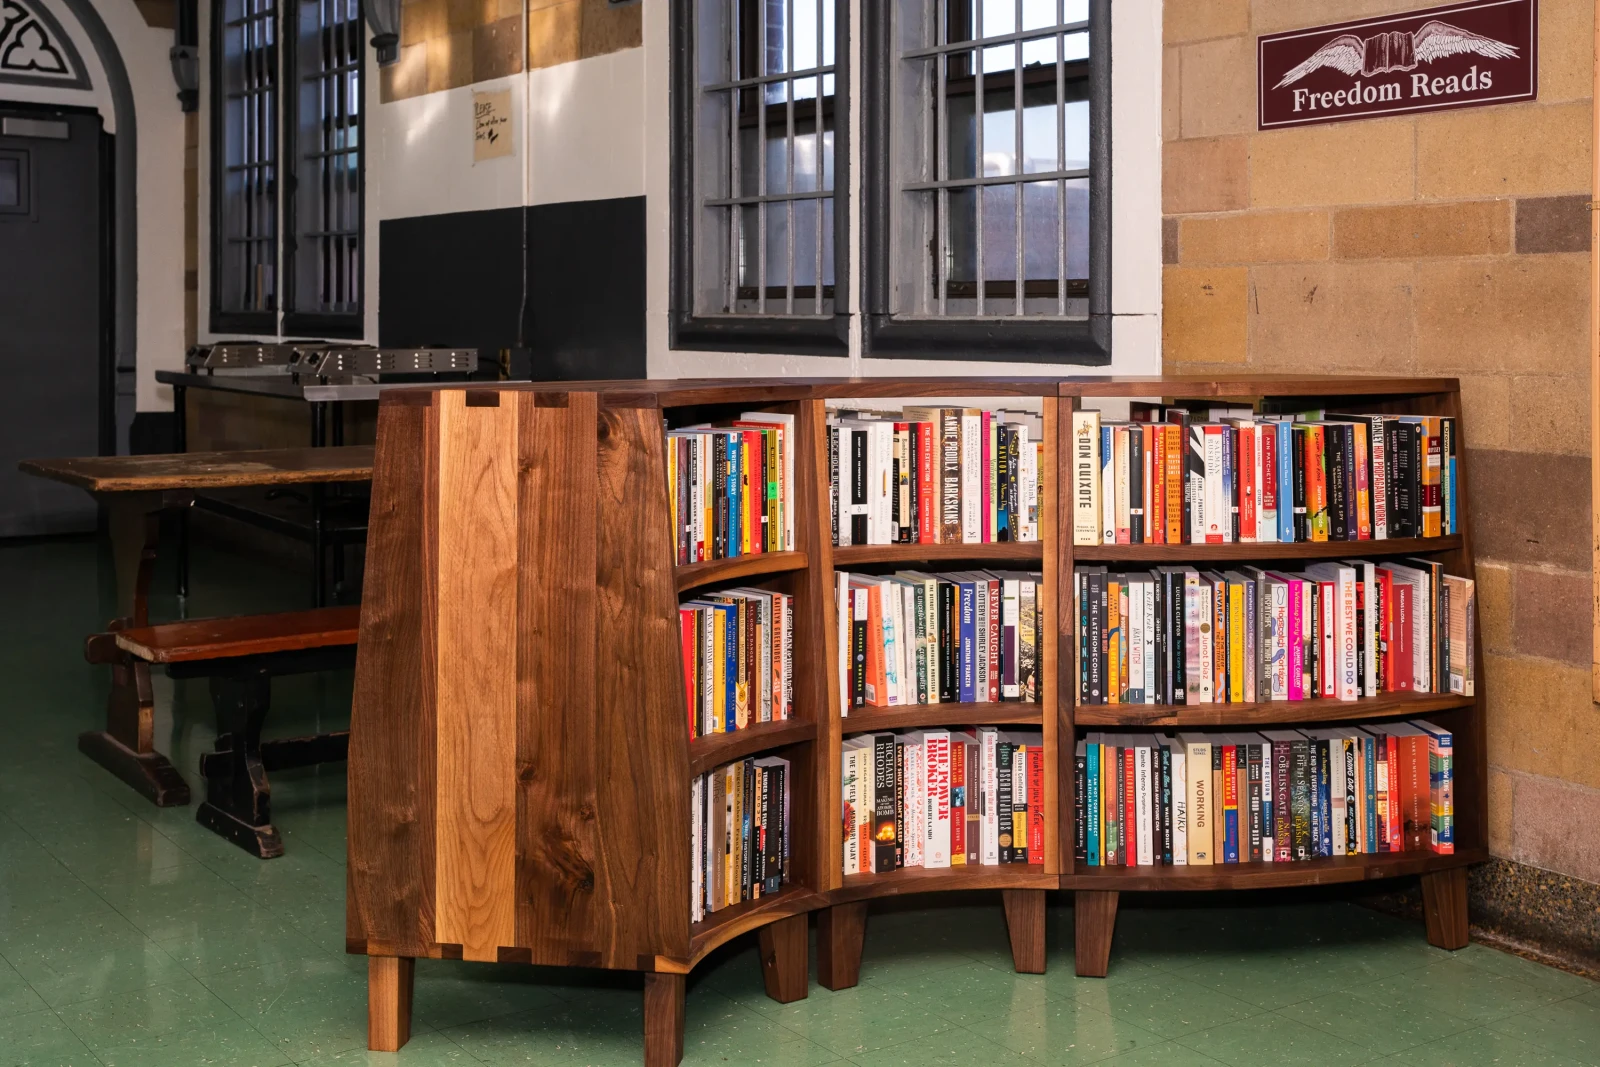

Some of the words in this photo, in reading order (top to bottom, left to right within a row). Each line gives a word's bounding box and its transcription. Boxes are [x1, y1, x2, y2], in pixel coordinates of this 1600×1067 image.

[1292, 80, 1402, 112] Freedom
[1410, 65, 1493, 98] Reads
[944, 416, 957, 439] ANNIE
[1373, 417, 1383, 443] STANLEY
[945, 442, 957, 471] PROULX
[1079, 438, 1091, 458] DON
[1374, 446, 1384, 459] HOW
[1079, 463, 1091, 508] QUIXOTE
[1374, 462, 1385, 503] PROPAGANDA
[944, 478, 958, 524] BARKSKINS
[1376, 504, 1385, 526] WORKS
[964, 589, 973, 623] Freedom
[1345, 600, 1353, 620] BEST
[1277, 606, 1285, 648] Hopscotch
[1345, 623, 1353, 635] WE
[1133, 647, 1141, 664] WITCH
[1346, 638, 1354, 668] COULD
[1278, 654, 1287, 688] Cortázar
[1346, 670, 1354, 684] DO
[876, 743, 885, 788] RHODES
[885, 742, 893, 787] RICHARD
[927, 739, 937, 797] BROKER
[938, 736, 948, 769] THE
[1297, 754, 1305, 778] FIFTH
[999, 769, 1010, 791] OSCAR
[1278, 755, 1286, 792] OBELISK
[938, 771, 948, 820] POWER
[1196, 780, 1205, 828] WORKING
[1297, 780, 1305, 814] SEASON
[999, 795, 1011, 830] HIJUELOS
[1177, 801, 1185, 832] HAIKU
